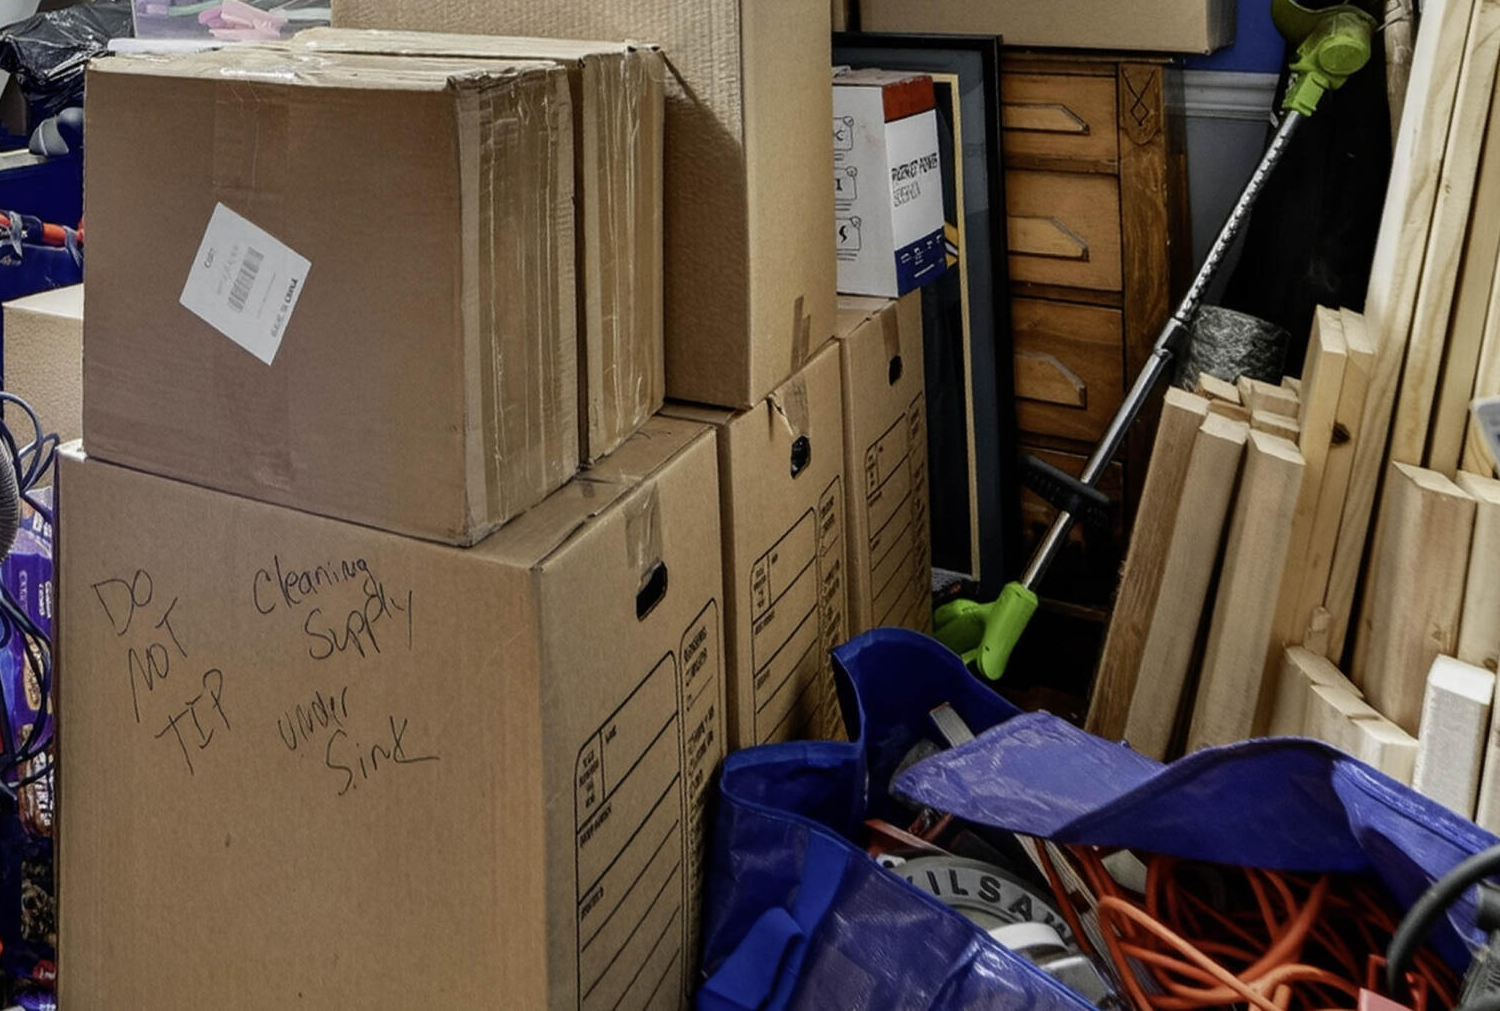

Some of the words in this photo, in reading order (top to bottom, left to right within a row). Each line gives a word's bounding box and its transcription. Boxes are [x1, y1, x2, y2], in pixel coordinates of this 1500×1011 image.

[90, 568, 153, 637] DO
[253, 554, 380, 615] Cleaning
[304, 581, 413, 661] Supply
[128, 596, 188, 724] NOT
[155, 668, 232, 777] TIP
